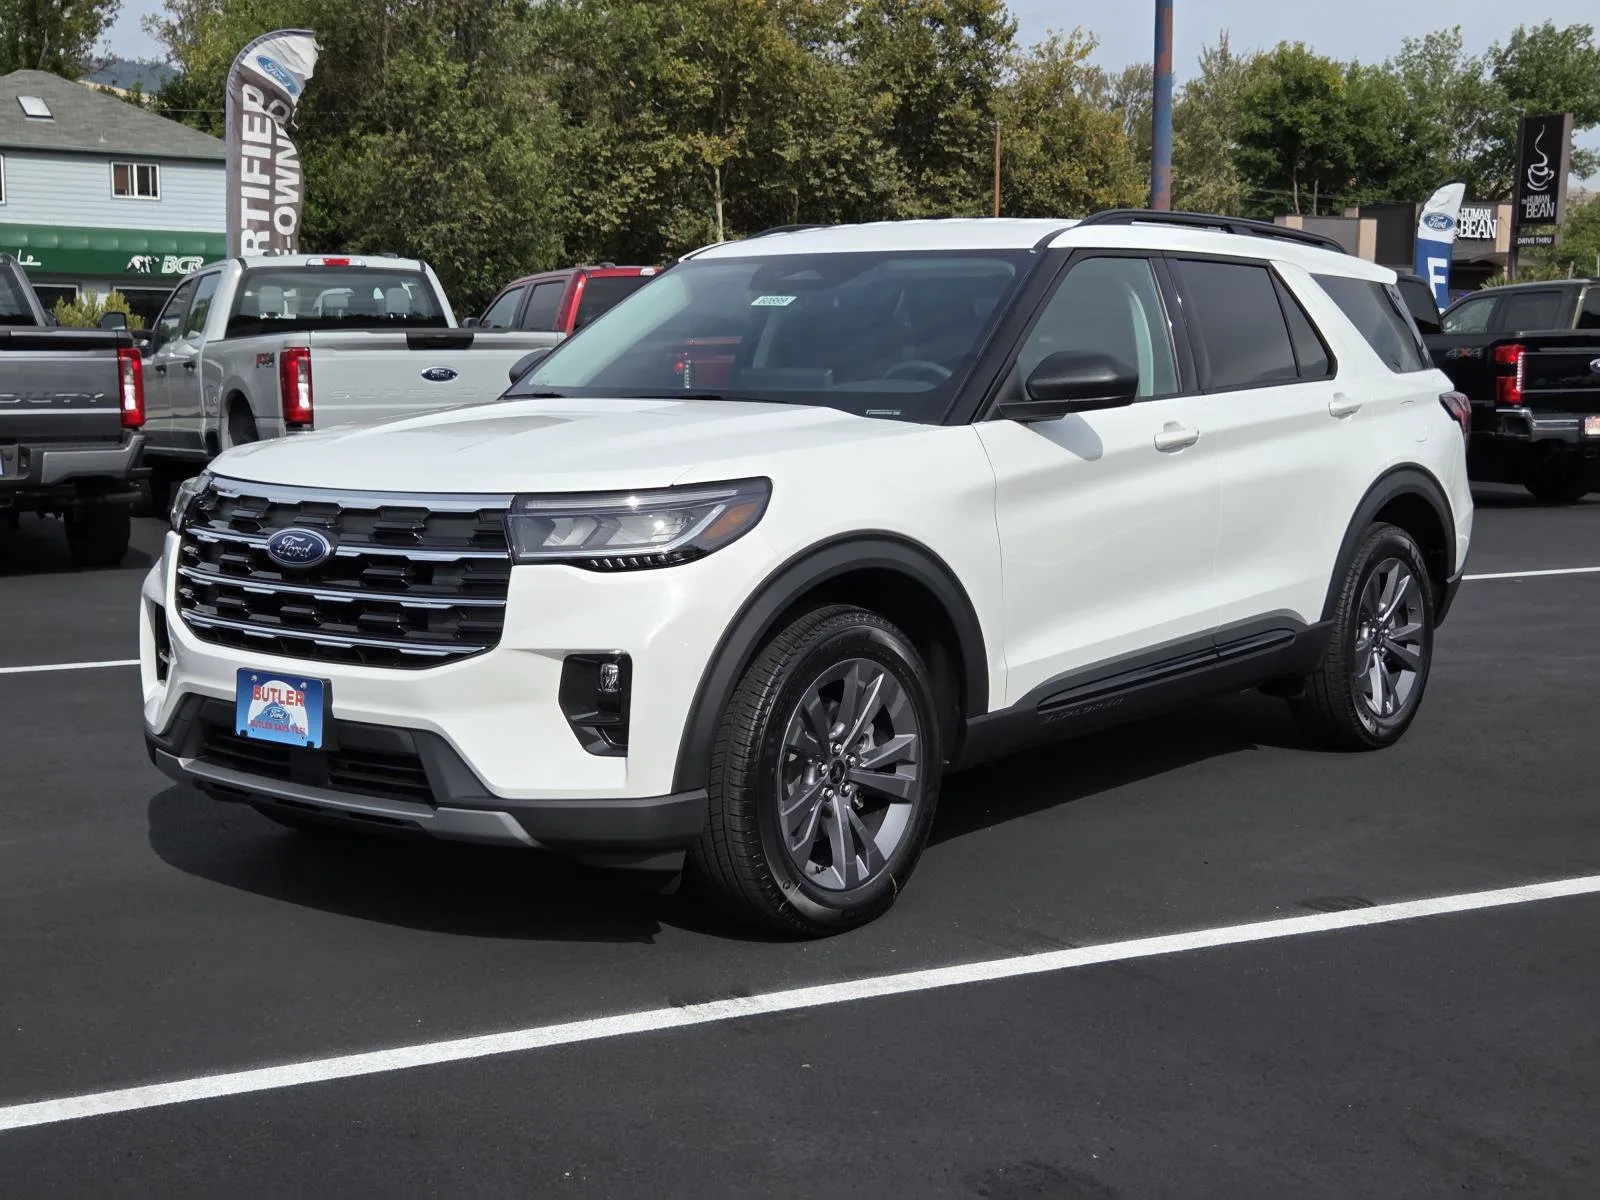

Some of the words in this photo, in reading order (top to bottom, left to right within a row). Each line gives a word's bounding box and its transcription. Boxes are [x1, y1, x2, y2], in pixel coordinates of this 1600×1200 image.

[241, 83, 272, 256] RTIFIED
[1527, 194, 1551, 203] HUMAN
[1460, 207, 1492, 220] HUMAN
[1526, 202, 1555, 218] BEAN
[1458, 219, 1497, 239] BEAN
[1517, 237, 1535, 245] DRIVE
[1536, 237, 1552, 245] THRU
[253, 684, 305, 707] BUTLER
